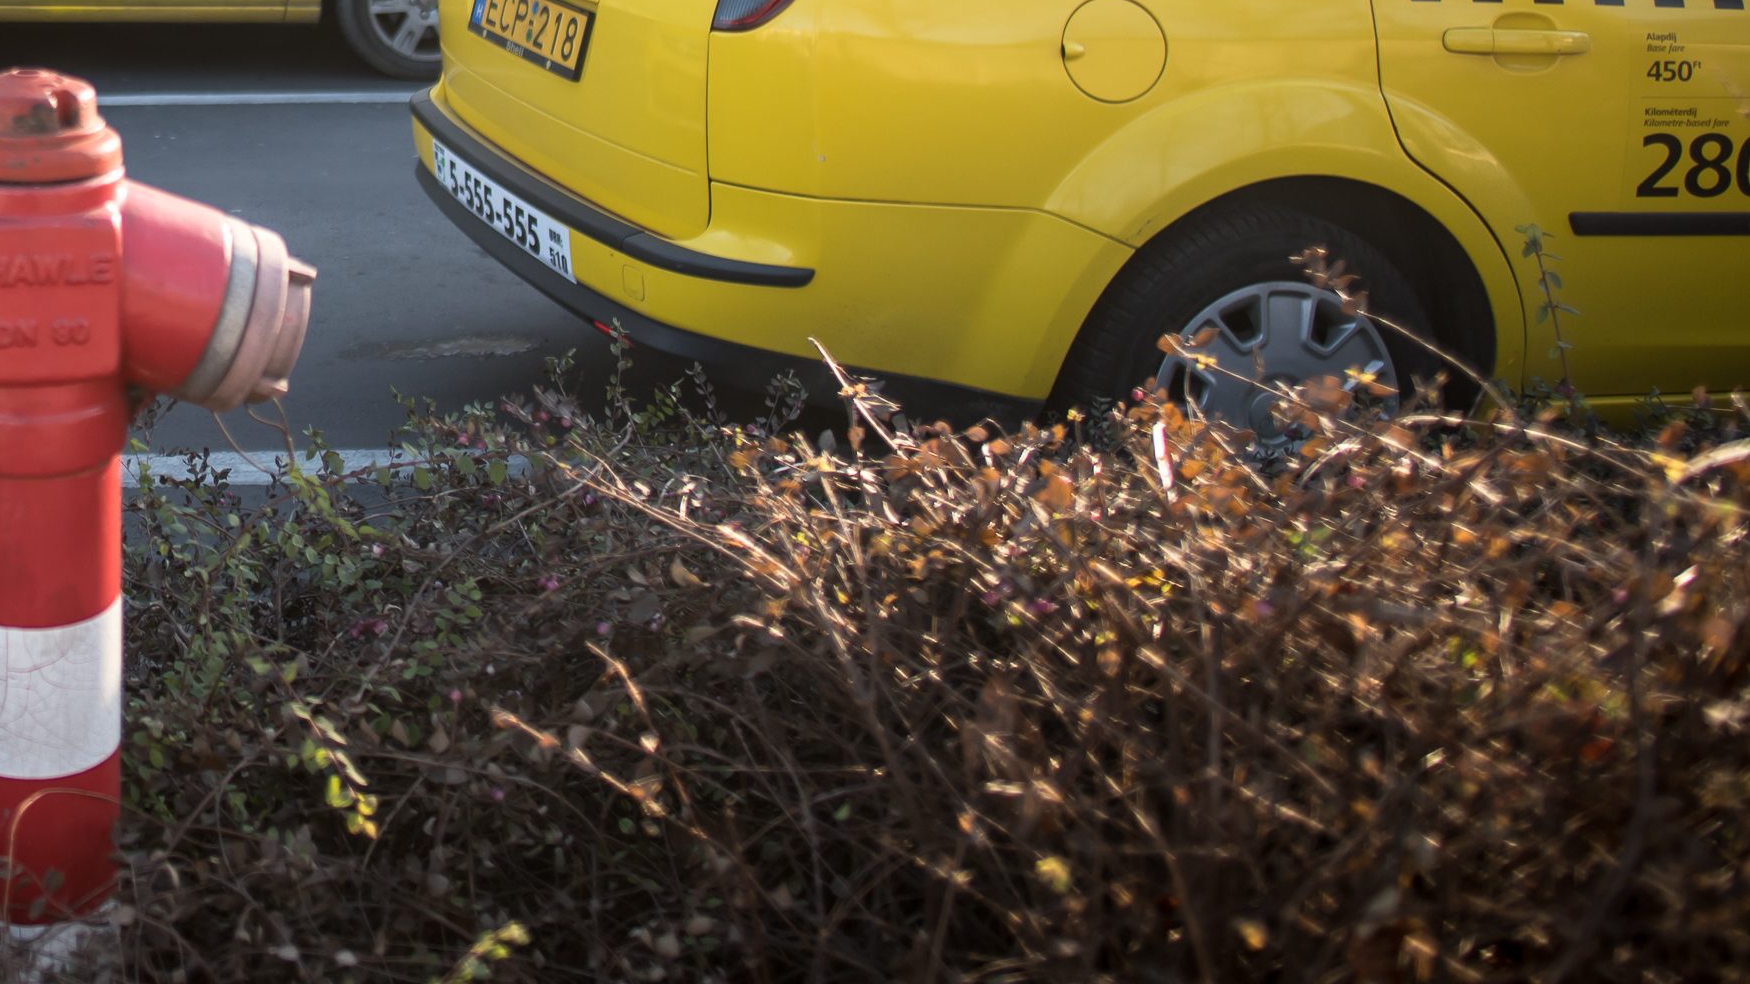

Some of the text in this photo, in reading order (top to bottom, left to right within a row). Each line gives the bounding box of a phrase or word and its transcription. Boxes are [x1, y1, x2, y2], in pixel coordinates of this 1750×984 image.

[1646, 43, 1686, 55] Base fare
[1646, 60, 1693, 82] 450
[1643, 118, 1730, 129] Kilometre-based fare
[1635, 132, 1750, 198] 28
[449, 159, 541, 256] 5-555-555
